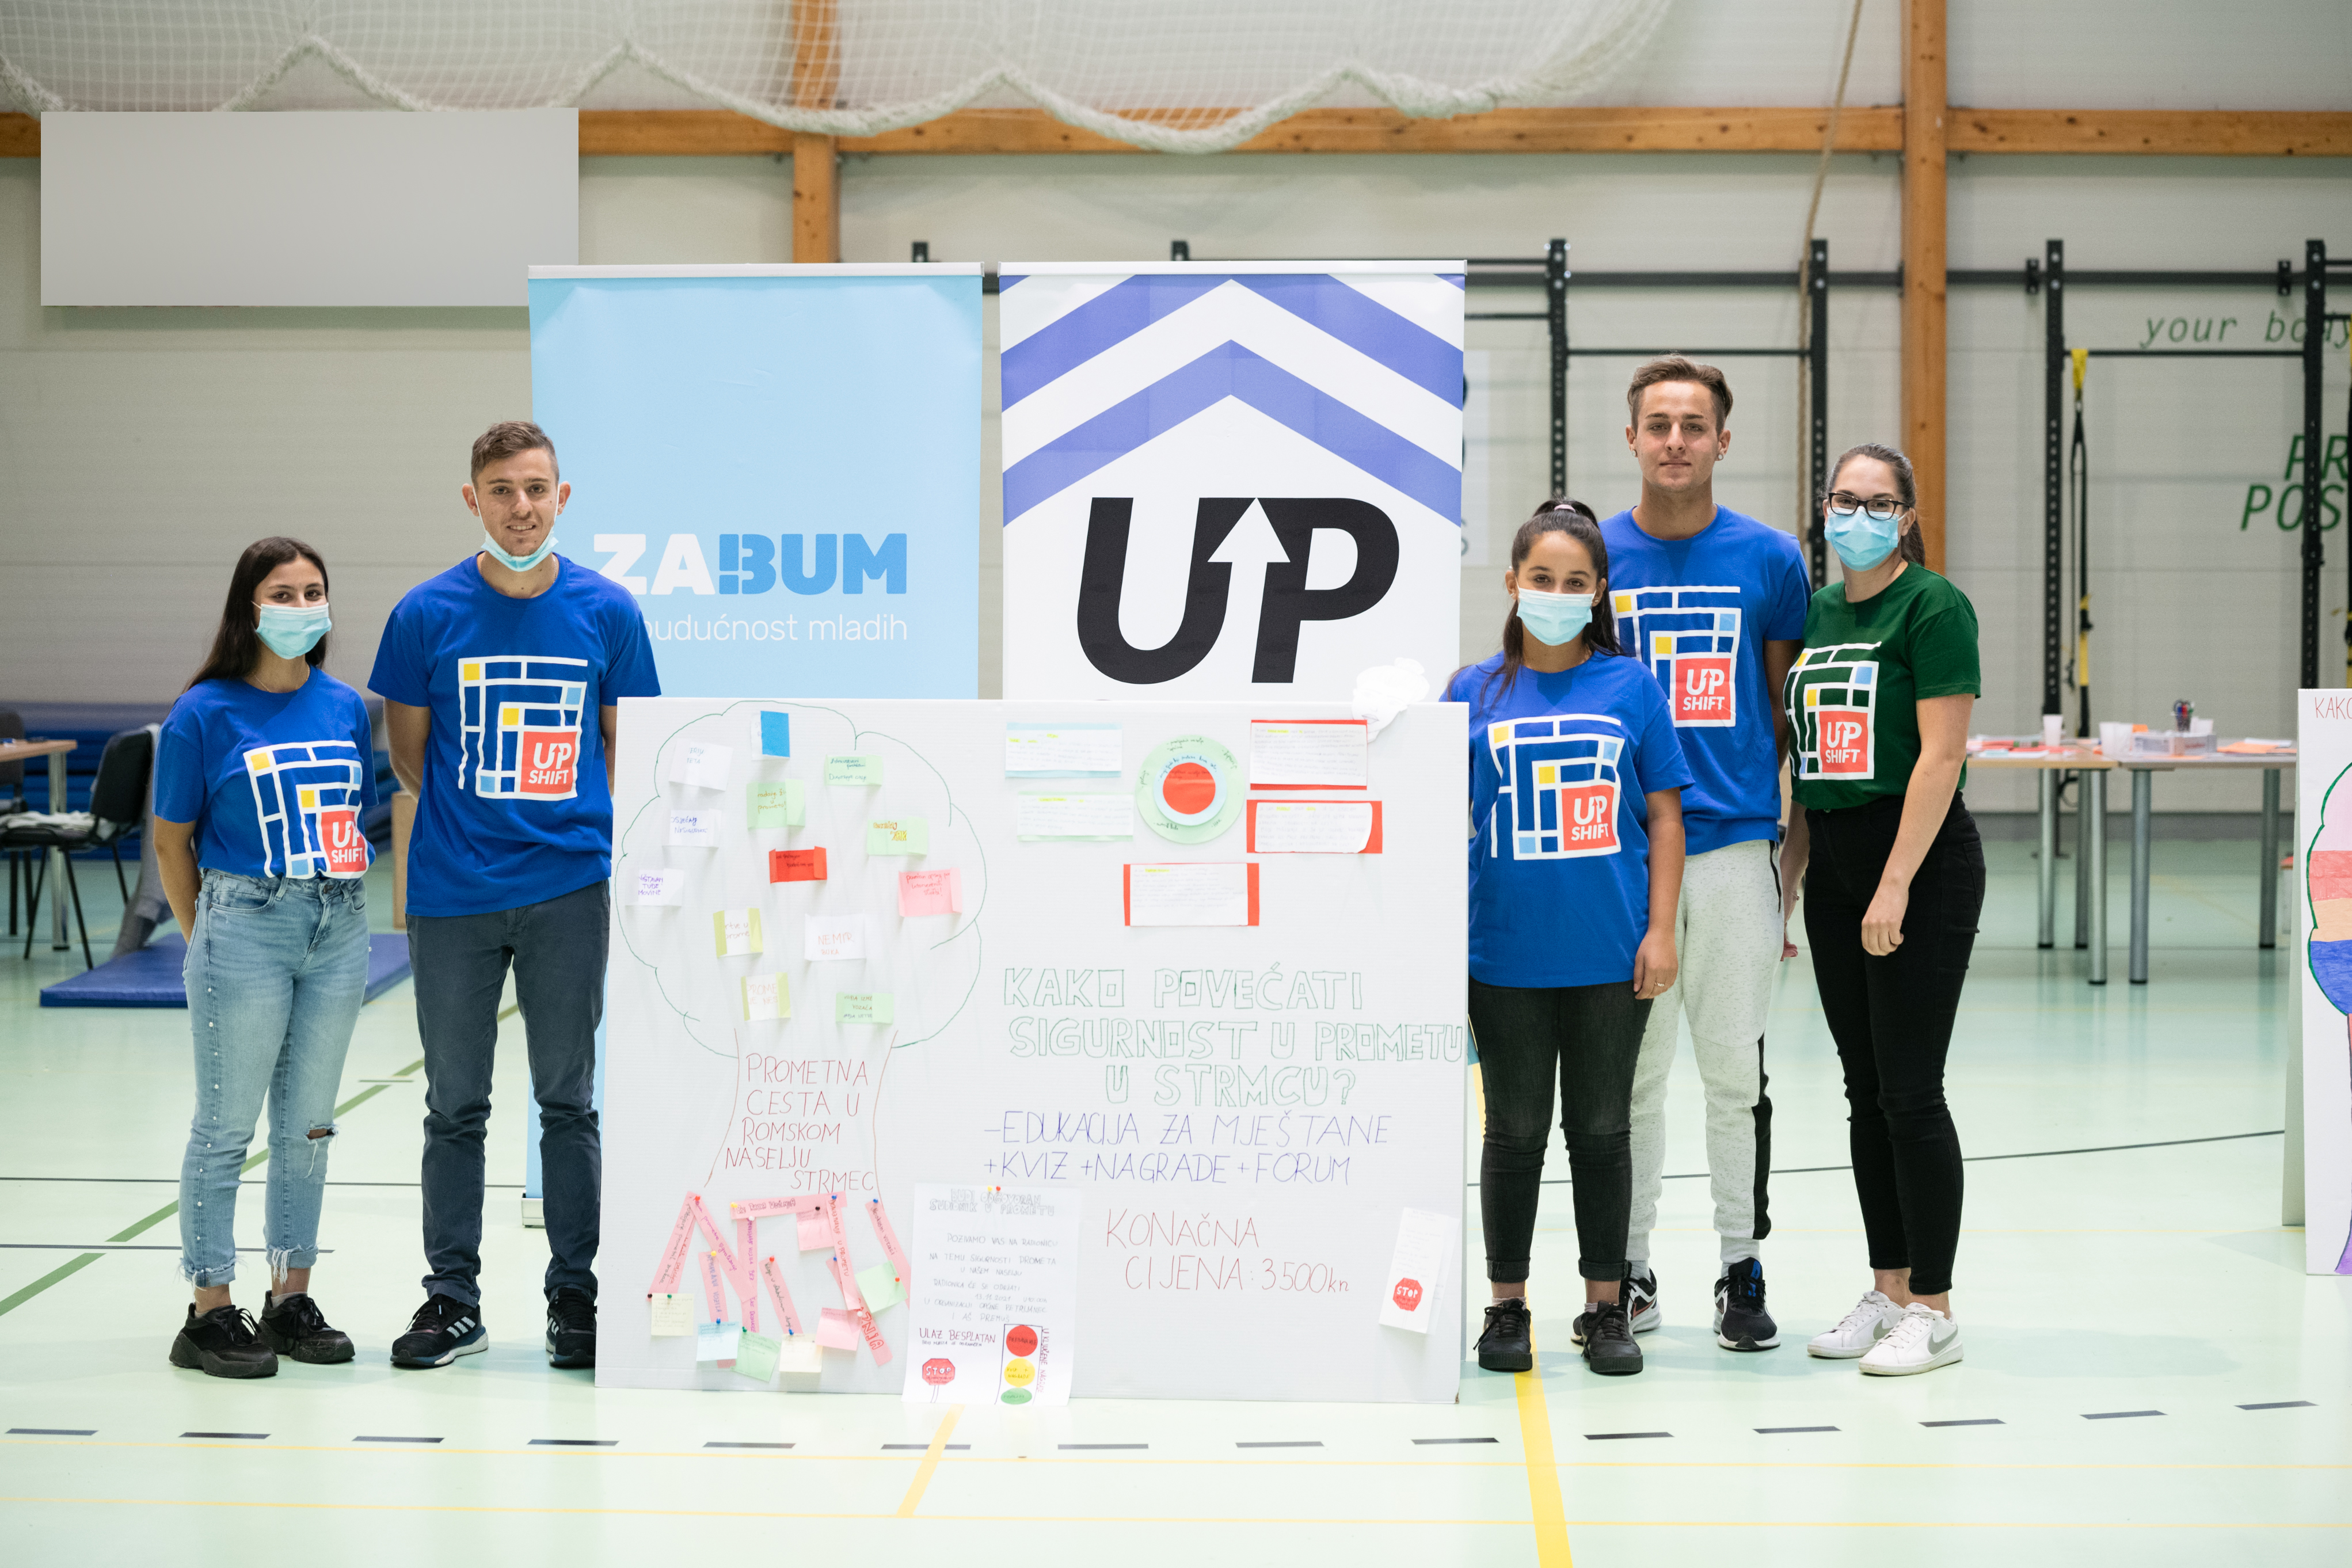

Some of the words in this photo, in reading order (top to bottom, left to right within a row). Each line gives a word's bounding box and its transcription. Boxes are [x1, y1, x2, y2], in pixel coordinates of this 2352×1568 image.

[2139, 316, 2239, 350] your
[593, 533, 907, 595] ZABUM
[1077, 497, 1399, 684] UP
[809, 614, 907, 641] mladih
[1685, 668, 1725, 696] UP
[1682, 696, 1725, 711] SHIFT
[1826, 721, 1863, 749] UP
[533, 742, 572, 770] UP
[1825, 749, 1861, 764] SHIFT
[528, 769, 569, 785] SHIFT
[1573, 795, 1608, 825] UP
[1570, 823, 1609, 841] SHIFT
[331, 847, 363, 863] SHIFT
[1004, 968, 1125, 1007] KAKO
[1154, 962, 1362, 1010] POVEĆATI
[1008, 1017, 1258, 1060] SIGURNOST
[1270, 1022, 1295, 1059] U
[1315, 1023, 1463, 1063] PROMETU
[745, 1052, 868, 1087] PROMETNA
[1105, 1065, 1129, 1103] U
[1154, 1064, 1356, 1107] STRMCU?
[747, 1090, 831, 1118] CESTA
[846, 1093, 860, 1117] U
[741, 1117, 840, 1145] ROMSKOM
[1160, 1114, 1192, 1144] ZA
[1212, 1109, 1392, 1147] MJEŠTANE
[725, 1145, 811, 1170] NASELJU
[790, 1169, 874, 1195] STRMEC
[947, 1233, 986, 1244] POZIVAMO
[991, 1236, 1006, 1246] VAS
[1106, 1208, 1259, 1249] KONAČNA
[929, 1253, 938, 1261] NA
[945, 1253, 965, 1262] TEMU
[970, 1253, 1011, 1265] SIGURNOSTI
[1018, 1255, 1057, 1265] PROMETA
[969, 1266, 989, 1275] NAŠEM
[933, 1278, 965, 1289] RADIONICA
[1396, 1286, 1419, 1299] STOP
[919, 1327, 943, 1339] ULAZ
[949, 1329, 996, 1344] BESPLATAN
[926, 1365, 952, 1376] STOP
